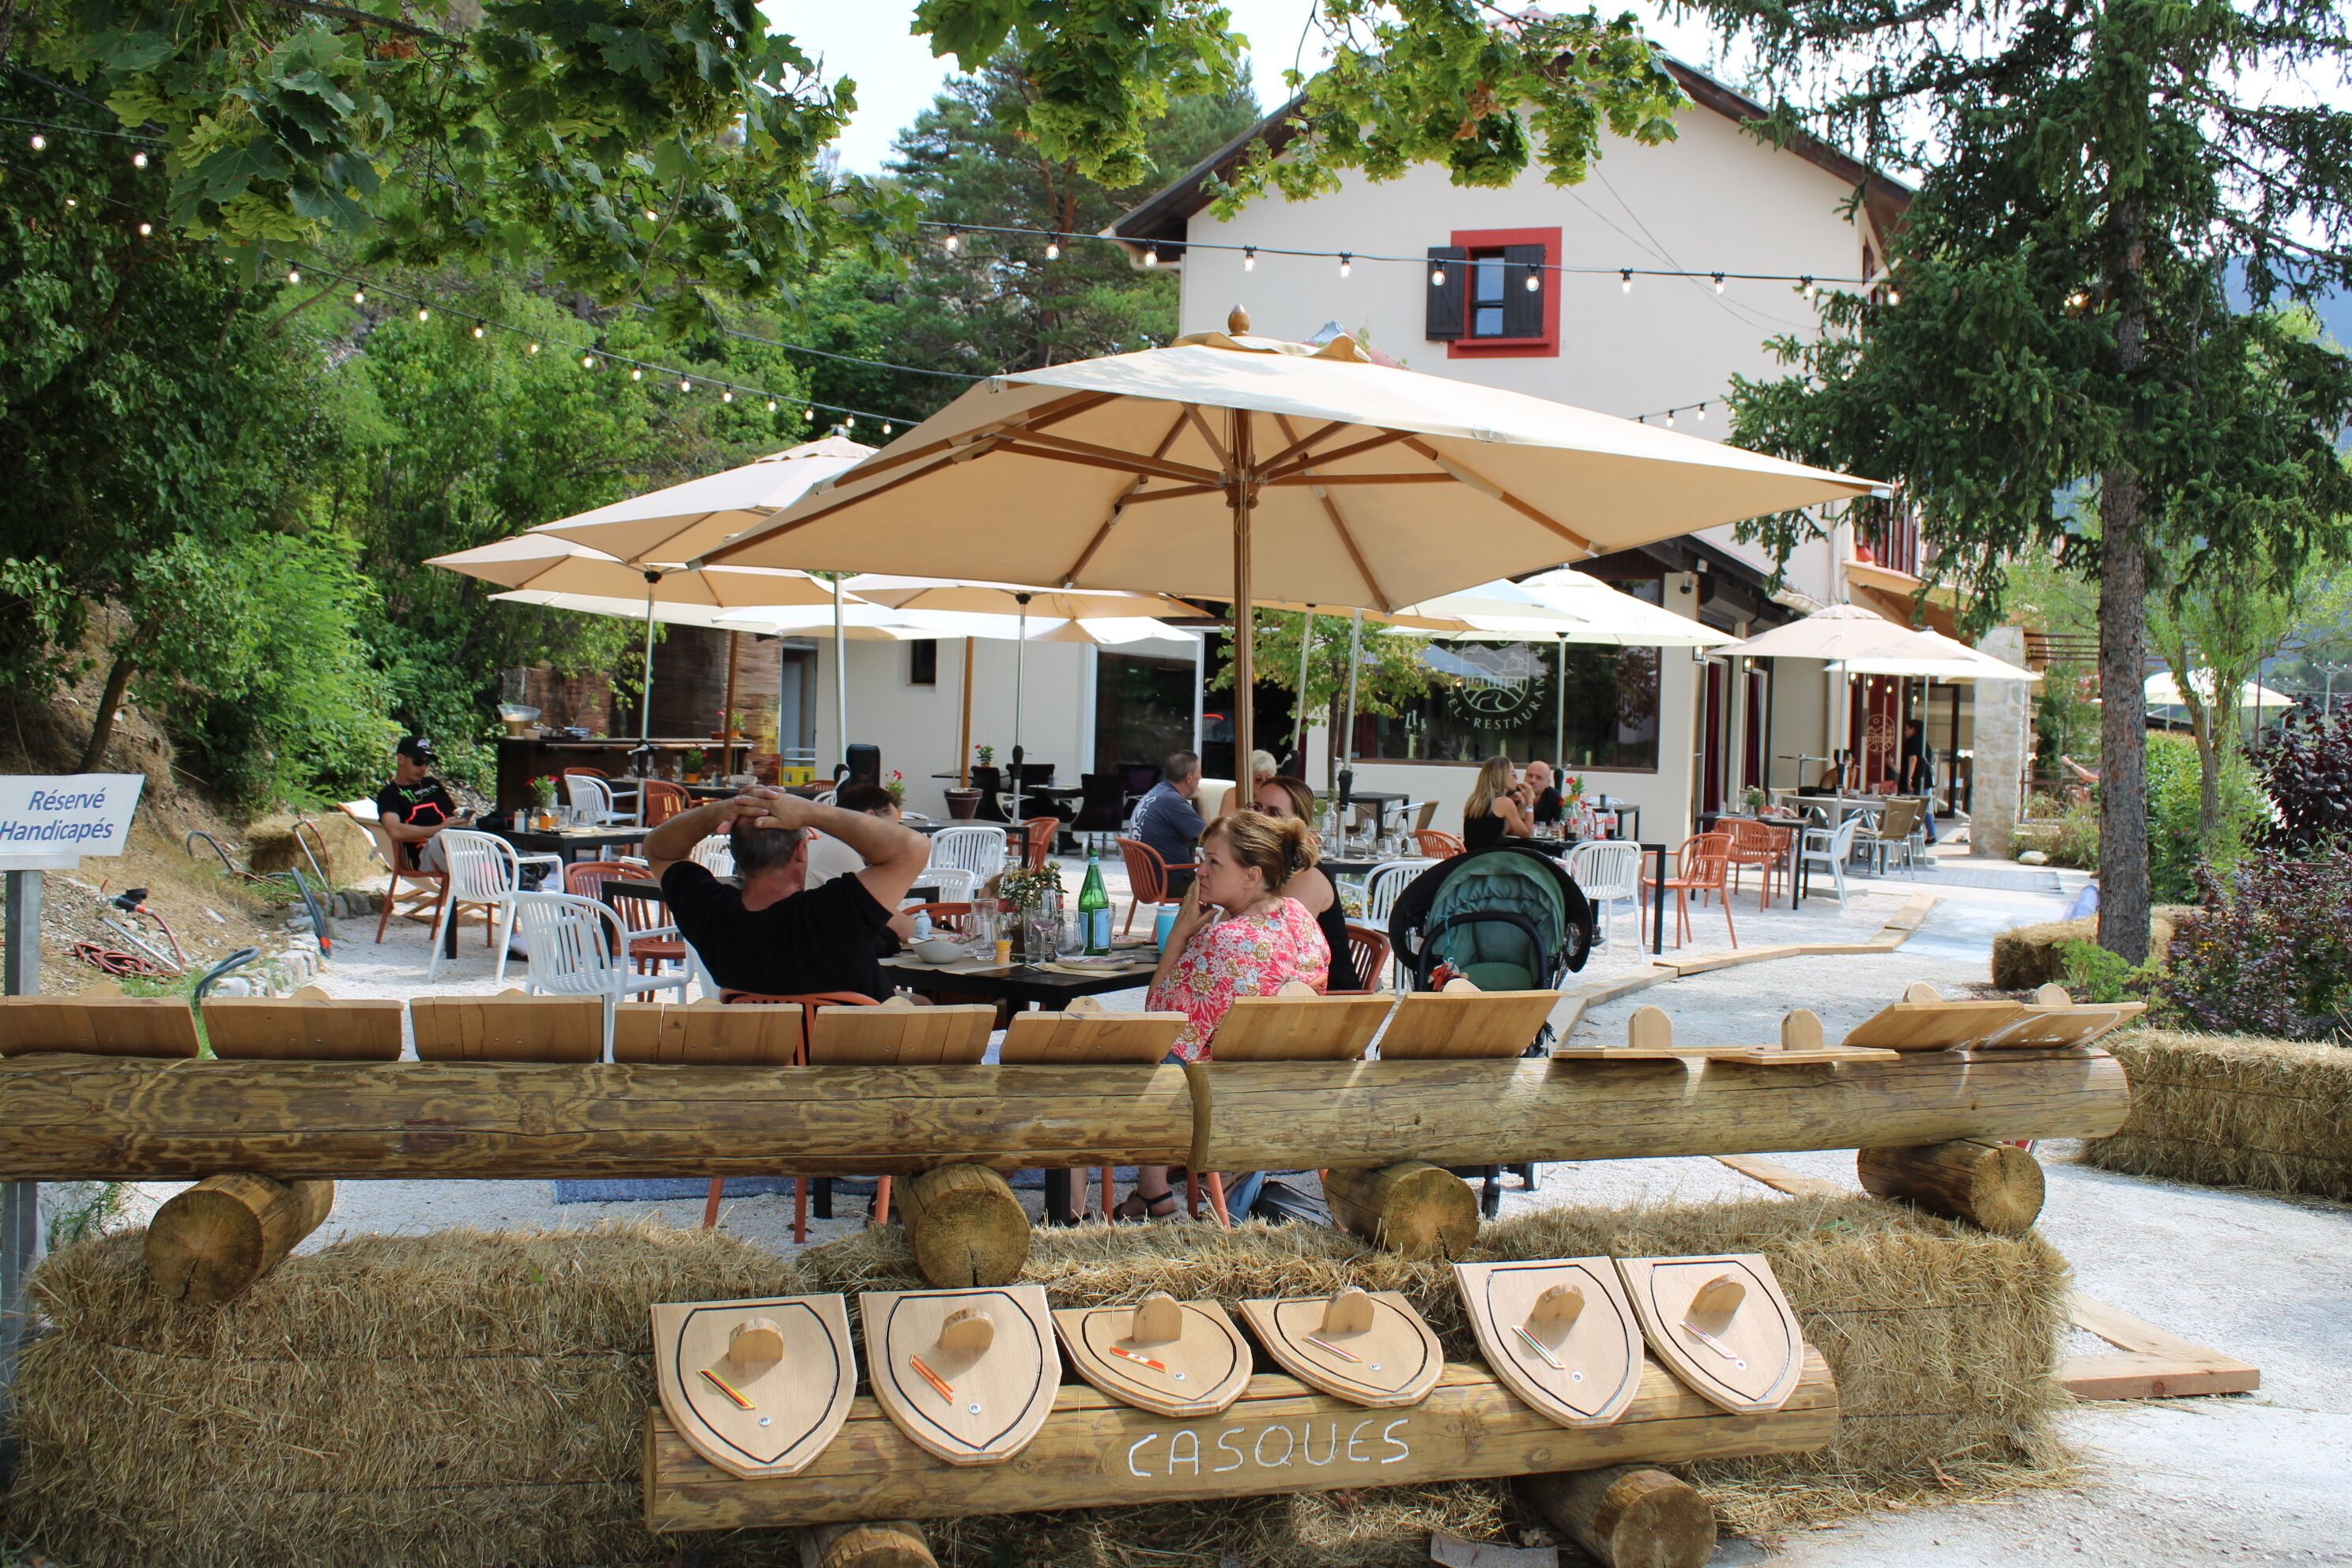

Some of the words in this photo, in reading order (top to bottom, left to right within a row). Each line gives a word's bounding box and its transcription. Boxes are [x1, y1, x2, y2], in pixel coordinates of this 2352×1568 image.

[28, 787, 107, 811] Réservé
[0, 817, 114, 843] Handicapés
[1128, 1419, 1411, 1477] CASQUES
